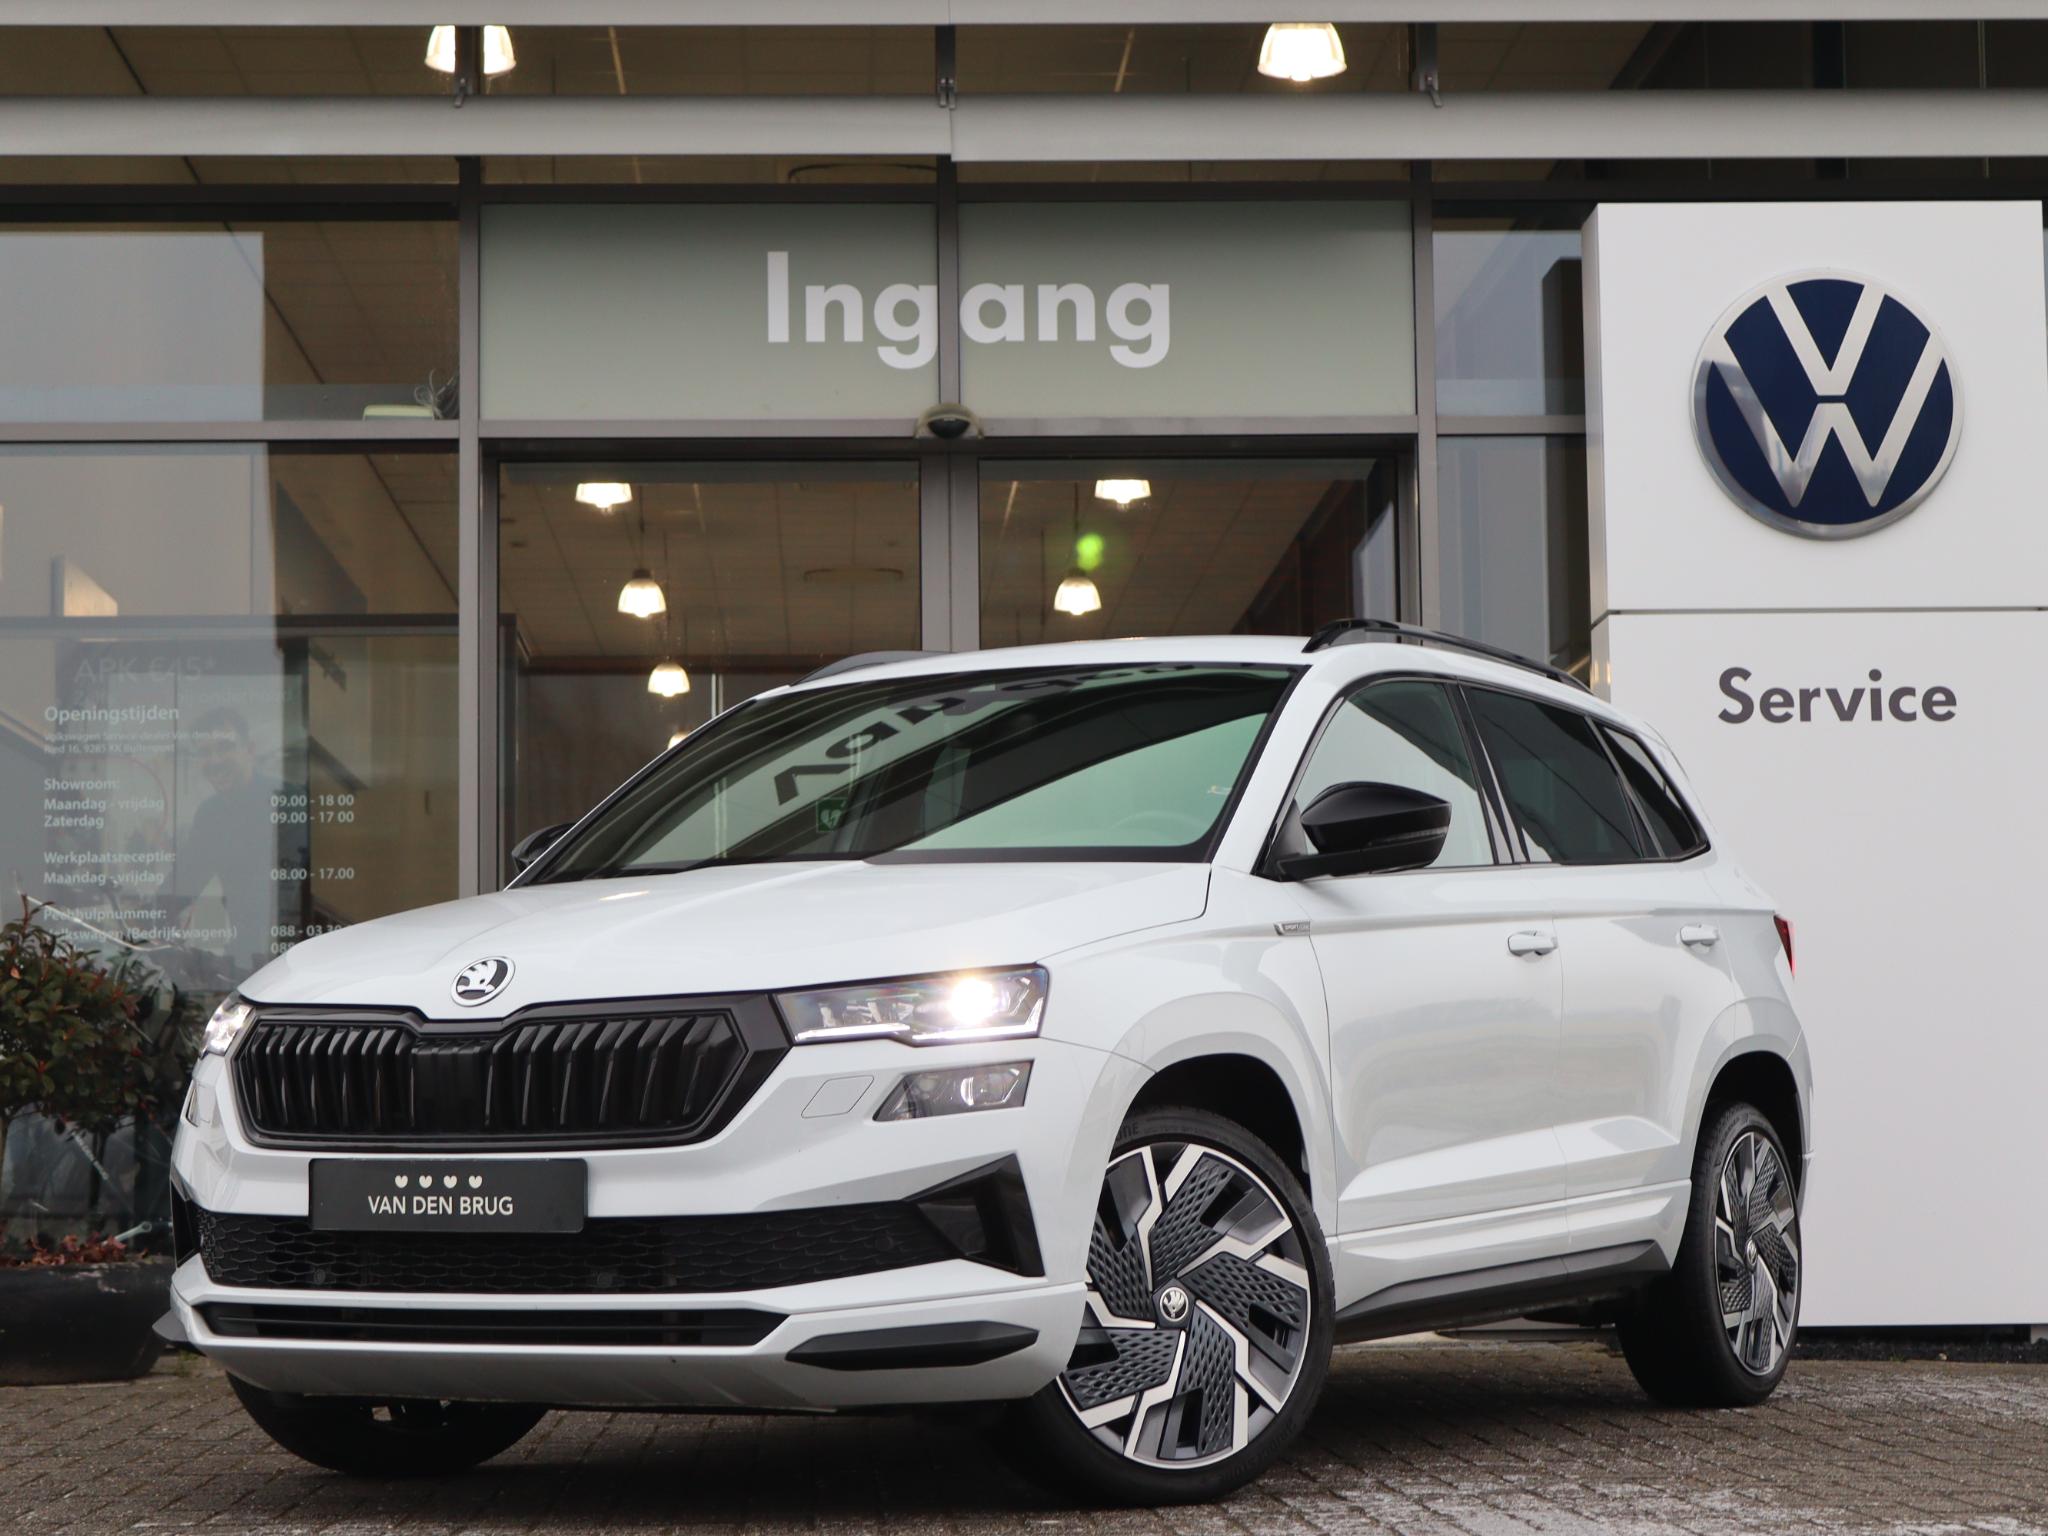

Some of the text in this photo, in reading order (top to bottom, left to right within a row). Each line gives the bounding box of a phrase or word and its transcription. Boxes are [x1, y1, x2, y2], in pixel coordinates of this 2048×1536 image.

[767, 251, 1171, 369] Ingang
[1718, 667, 1957, 723] Service
[45, 705, 180, 725] Openingstijden
[44, 778, 119, 790] Showroom:
[44, 799, 106, 812] Maandag
[118, 797, 165, 811] vrijdag
[270, 795, 308, 808] 09.00
[44, 815, 105, 829] Zaterdag
[270, 812, 308, 824] 09.00
[44, 851, 177, 866] Werkplaatsreceptie:
[44, 872, 106, 886] Maandag
[118, 870, 165, 885] vrijdag
[270, 868, 308, 880] 08.00
[319, 867, 355, 880] 17.00
[270, 925, 296, 937] 088
[368, 1195, 514, 1216] VAN DEN BRUG
